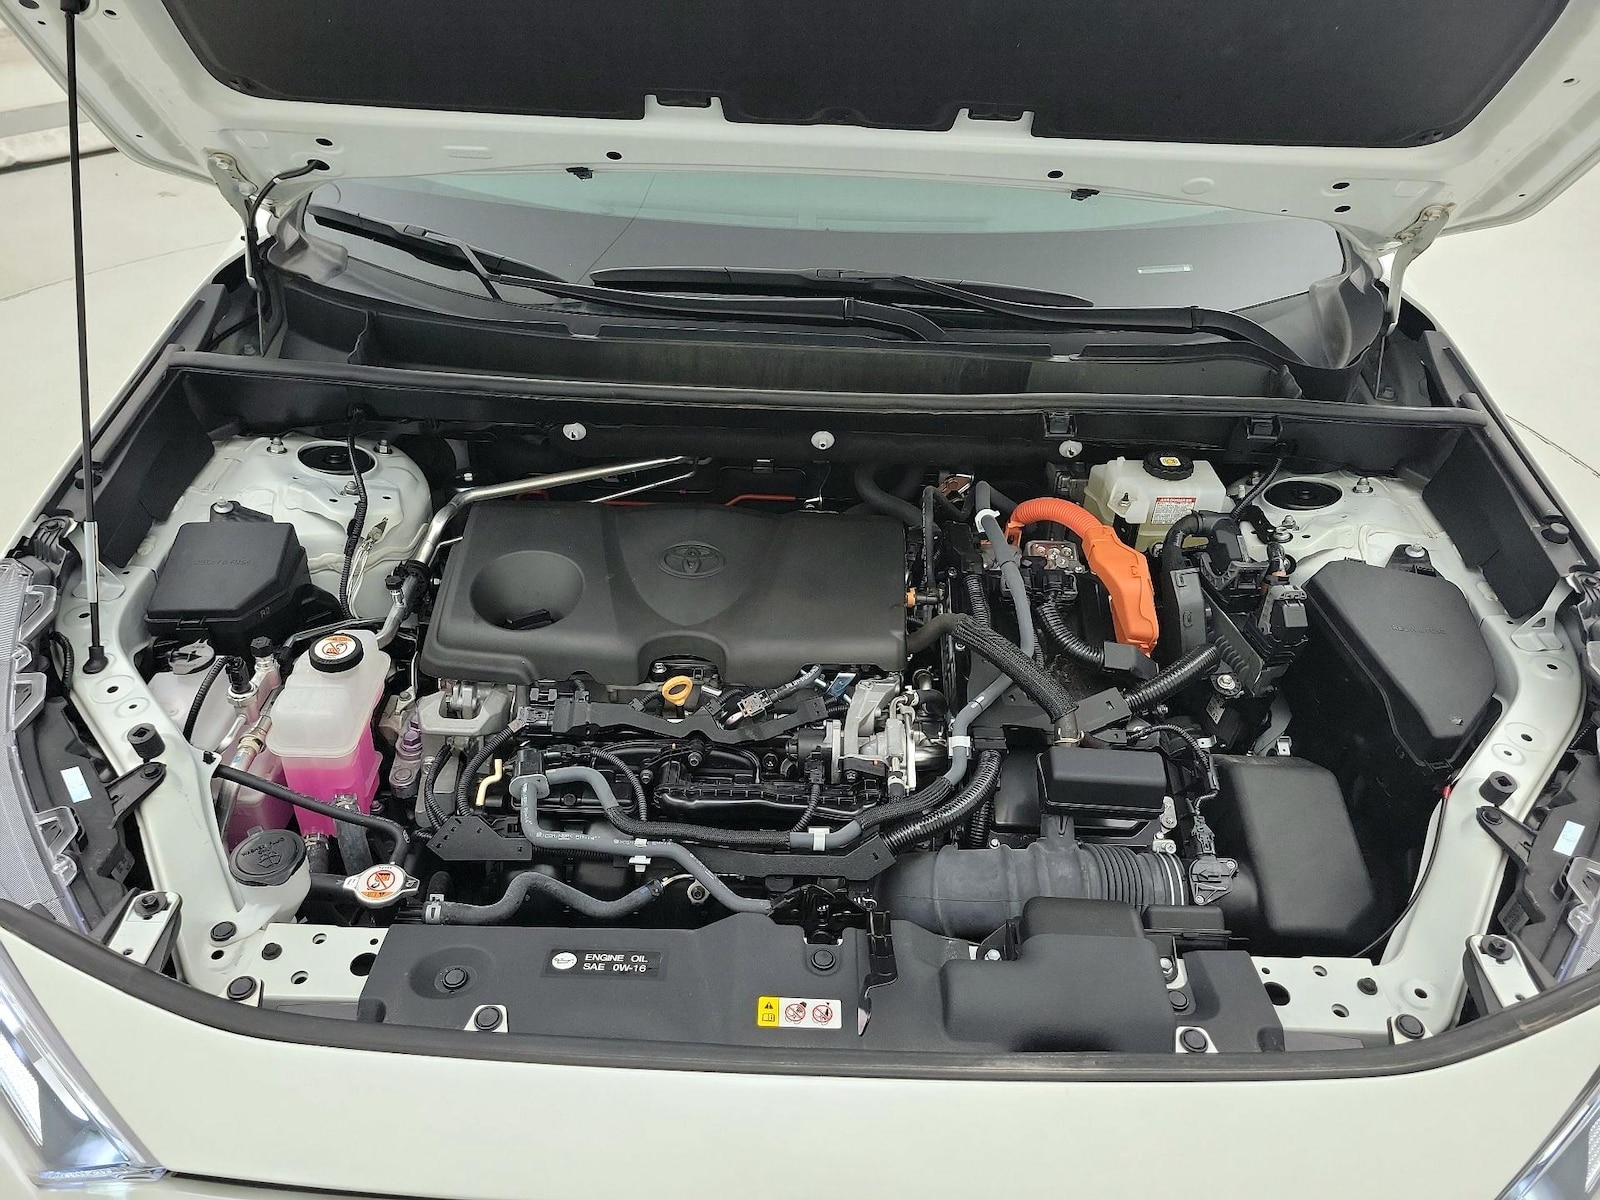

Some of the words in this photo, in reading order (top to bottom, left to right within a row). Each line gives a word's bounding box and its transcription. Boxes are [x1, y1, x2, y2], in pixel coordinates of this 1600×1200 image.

[585, 953, 625, 962] ENGINE
[630, 955, 648, 963] OIL
[583, 962, 605, 971] SAE
[612, 963, 647, 973] 0W-16
